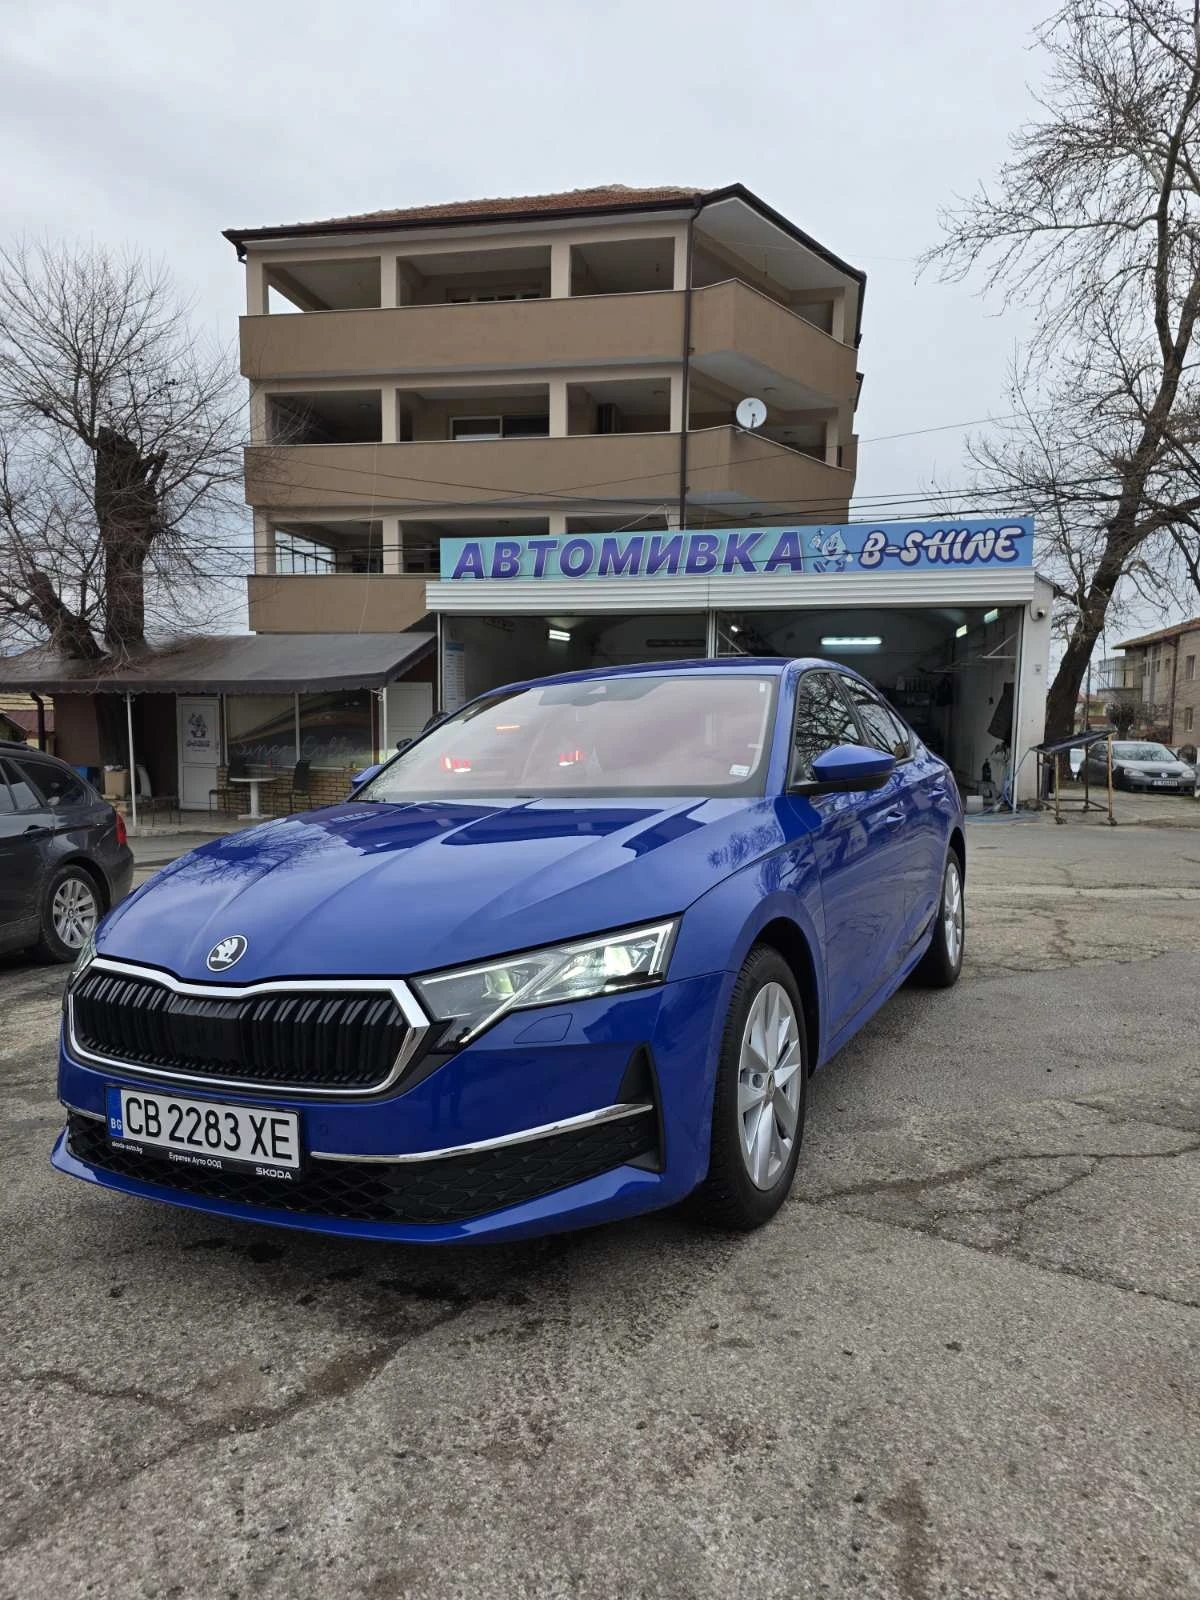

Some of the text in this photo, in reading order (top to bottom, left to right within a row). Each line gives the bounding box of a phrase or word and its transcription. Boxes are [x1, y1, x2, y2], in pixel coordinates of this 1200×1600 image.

[451, 531, 806, 580] АВТОМИВКА
[859, 524, 1025, 569] B-SHINE
[110, 1117, 122, 1130] BG
[125, 1097, 293, 1160] CB 2283 XE
[255, 1167, 293, 1180] SKODA
